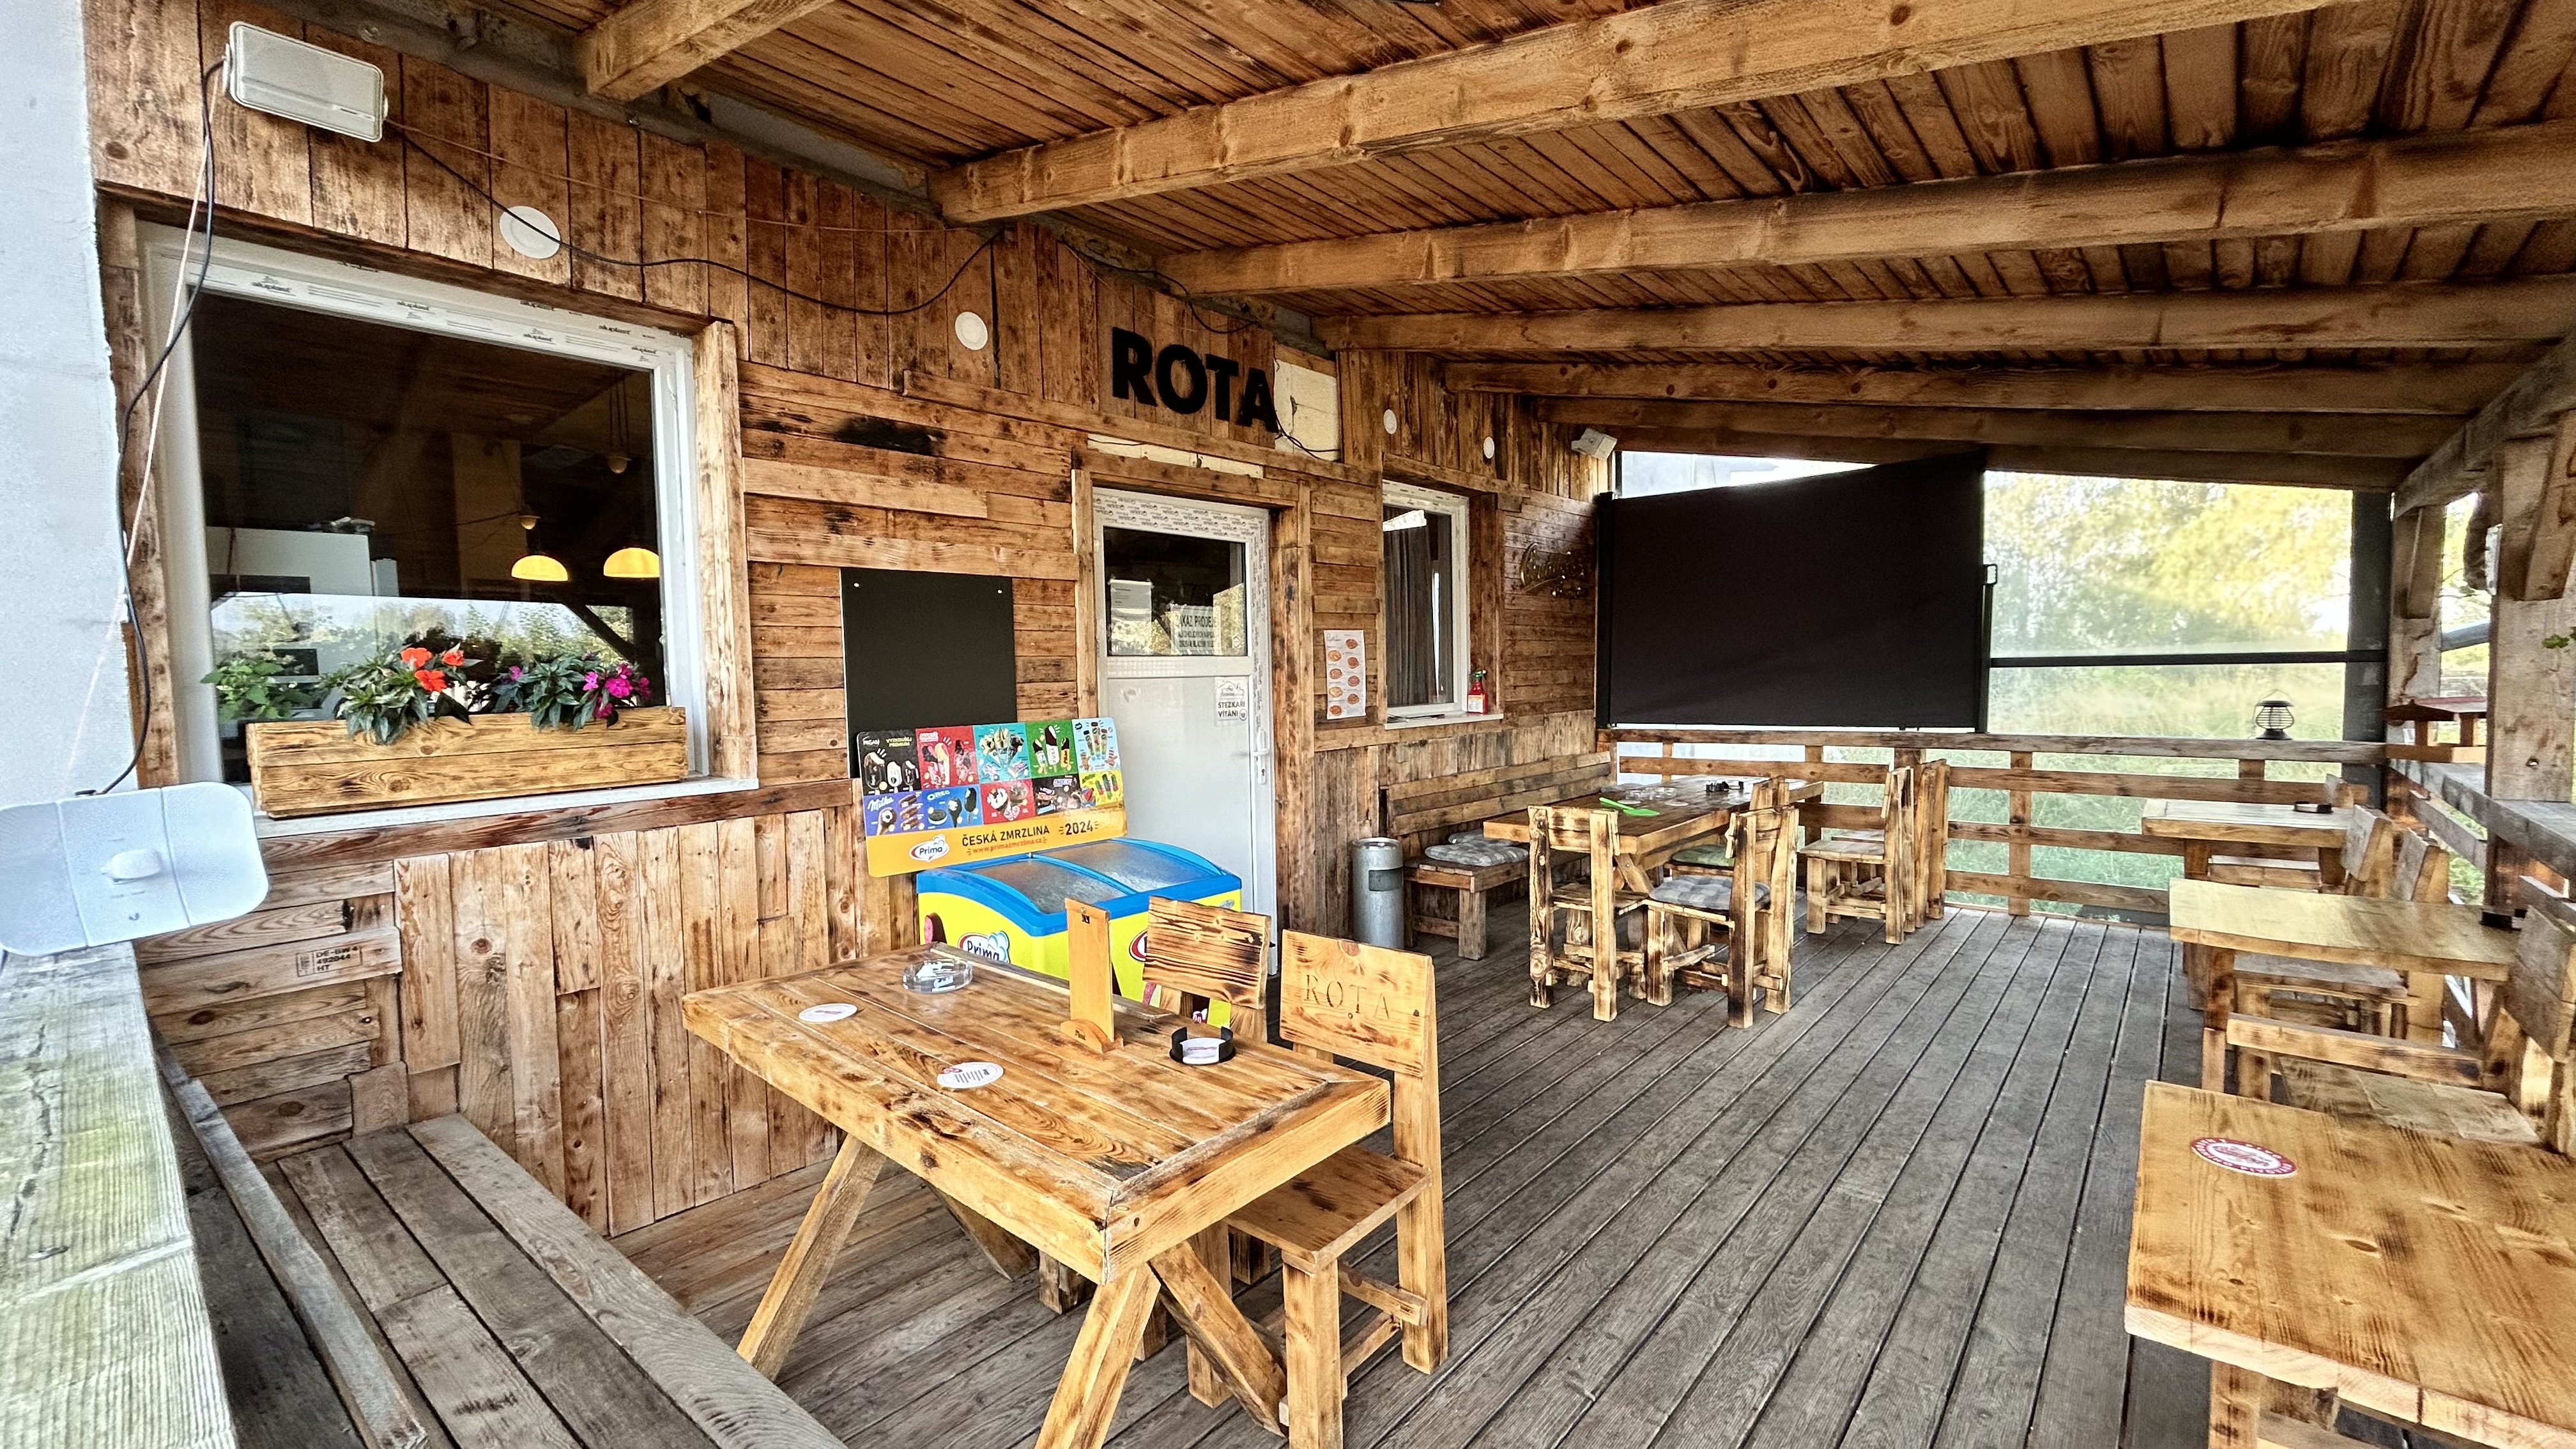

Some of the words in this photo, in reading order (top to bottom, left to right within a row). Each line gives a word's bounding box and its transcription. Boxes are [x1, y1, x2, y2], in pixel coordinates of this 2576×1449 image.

[598, 324, 631, 335] aluplast
[1112, 326, 1278, 433] ROTA
[1218, 700, 1245, 709] STEZKAŘI
[927, 790, 951, 801] OREO
[867, 796, 894, 812] Milka
[962, 830, 997, 847] ČESKÁ
[1000, 825, 1050, 841] ZMRZLINA
[1064, 820, 1094, 836] 2024
[919, 846, 943, 856] Prima
[972, 838, 1043, 854] www.primazmrzlina.cz
[967, 940, 1000, 960] Prima
[1304, 974, 1390, 1020] ROTA
